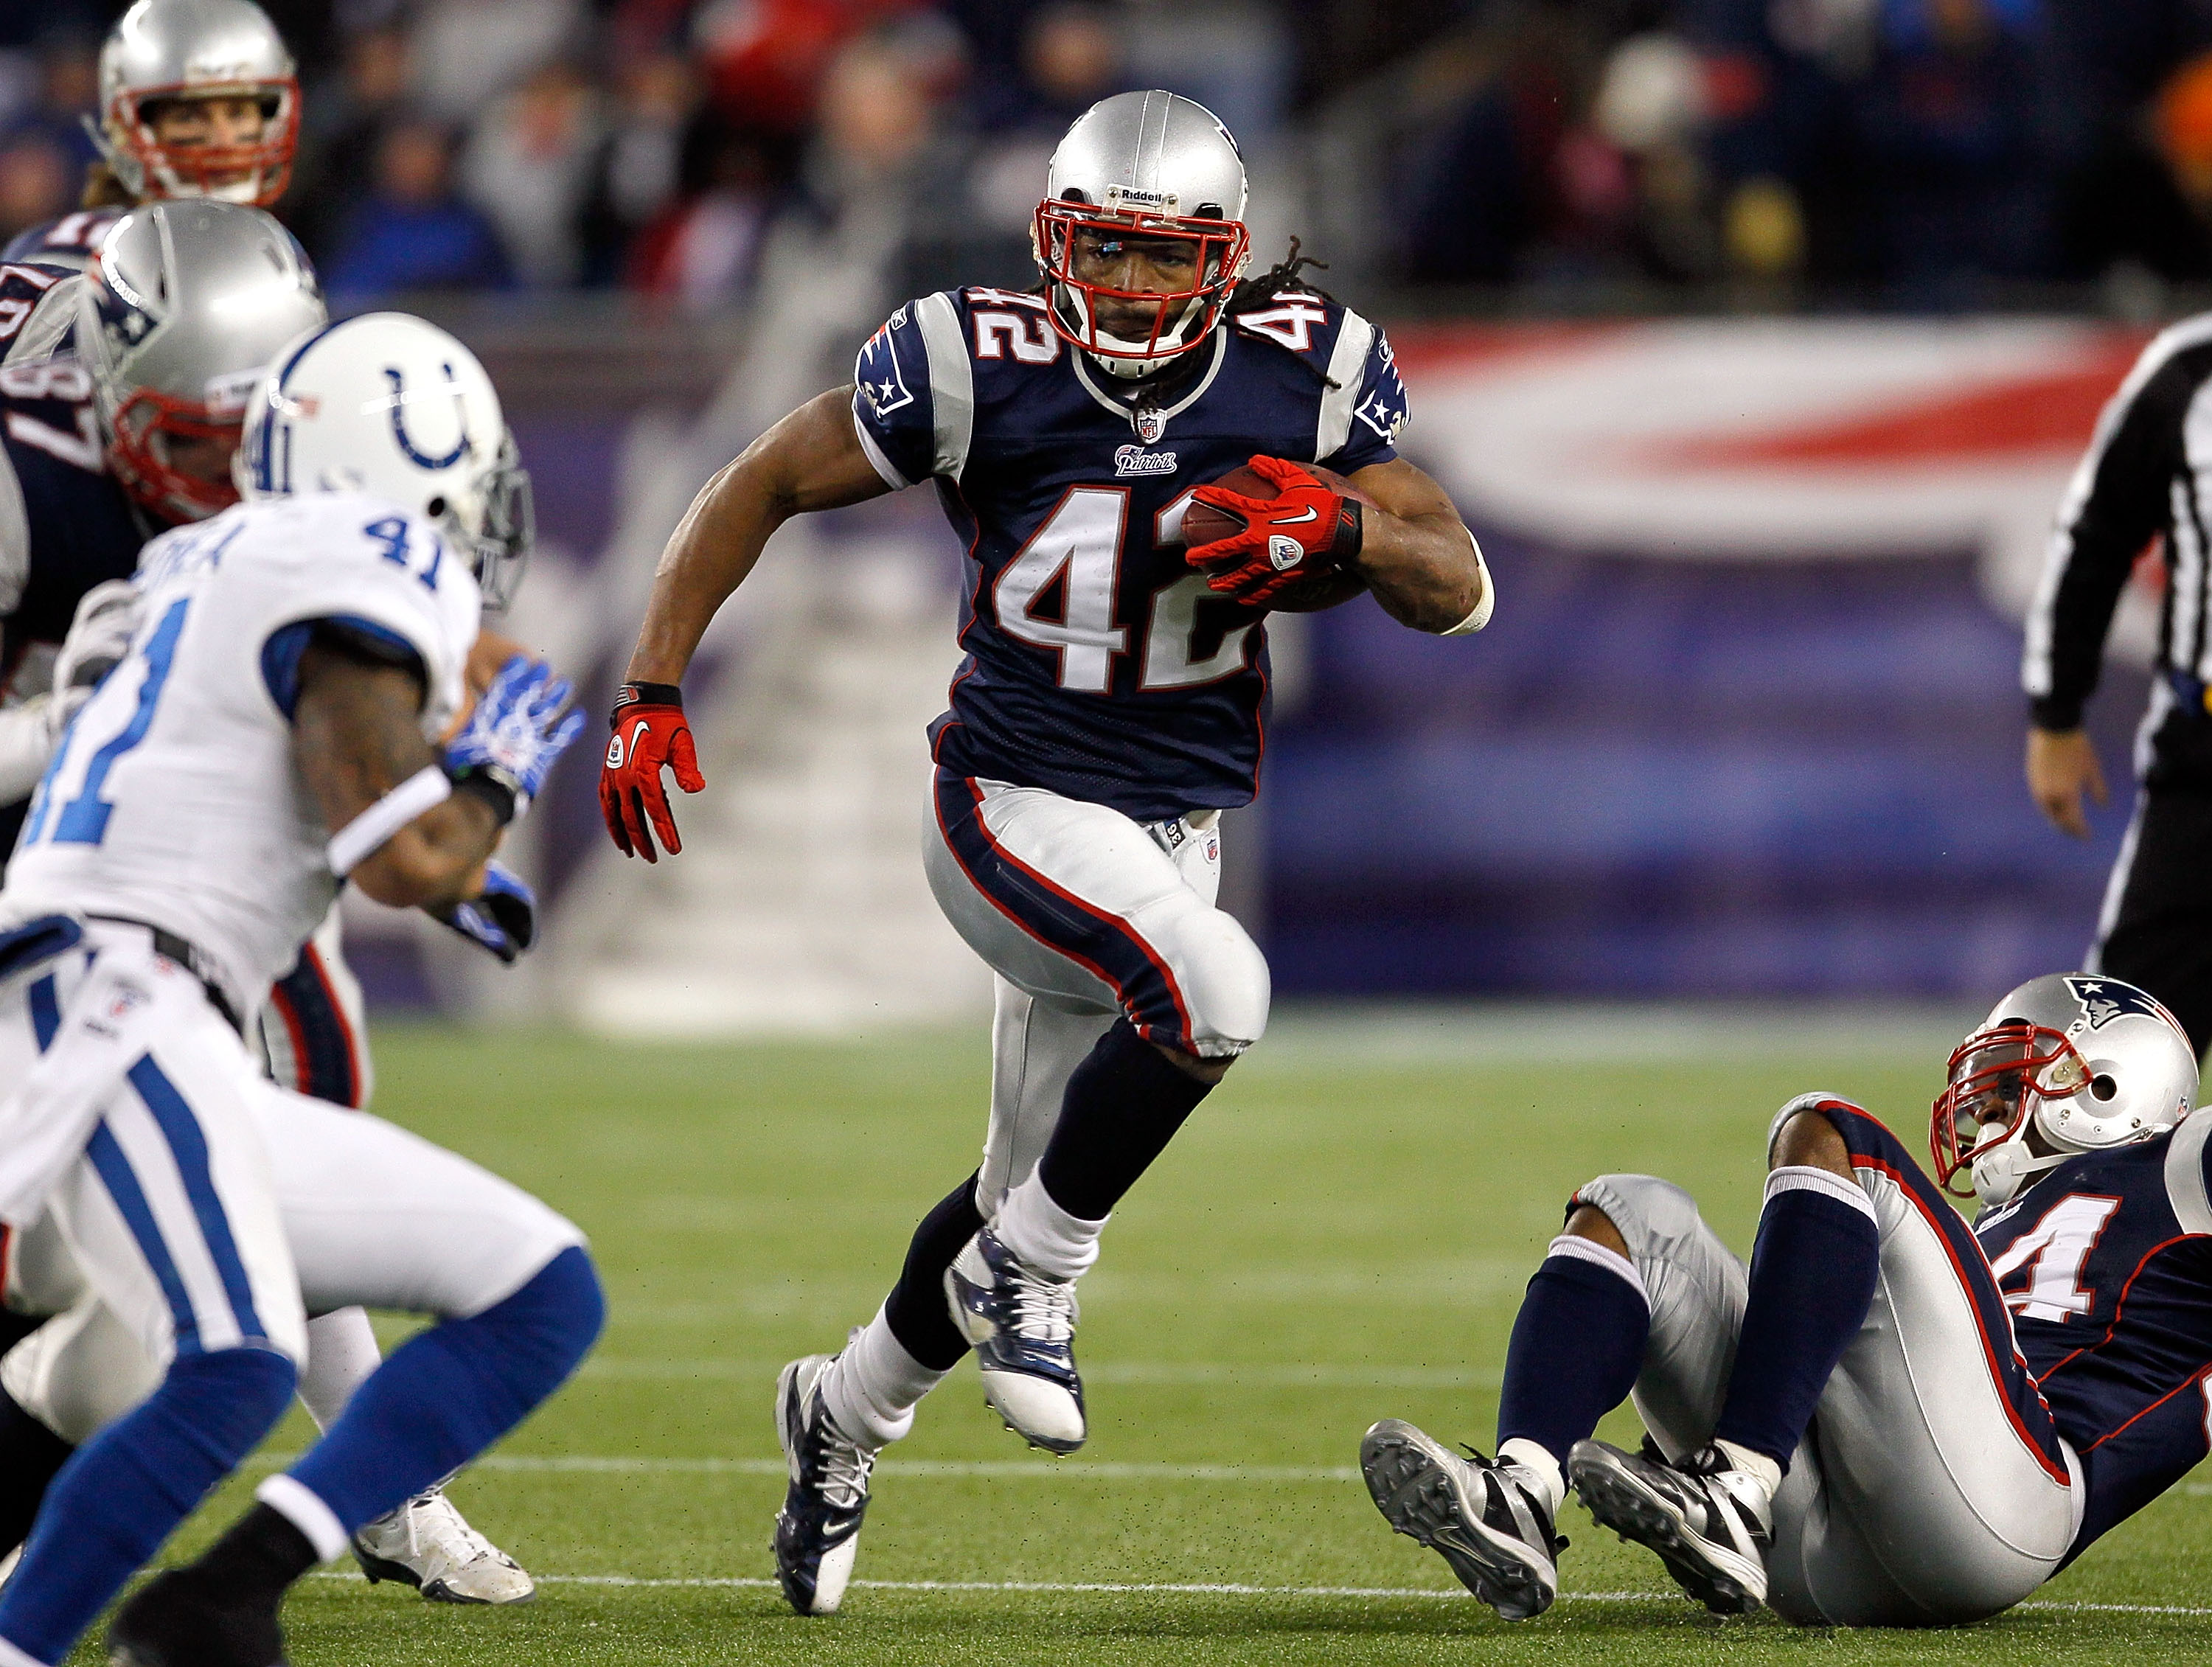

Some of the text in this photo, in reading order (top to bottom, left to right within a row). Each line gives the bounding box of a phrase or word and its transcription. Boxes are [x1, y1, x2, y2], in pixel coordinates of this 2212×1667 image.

[1121, 189, 1161, 202] Riddell
[1115, 452, 1178, 476] Patriots
[365, 517, 441, 590] 41
[992, 484, 1257, 696] 42
